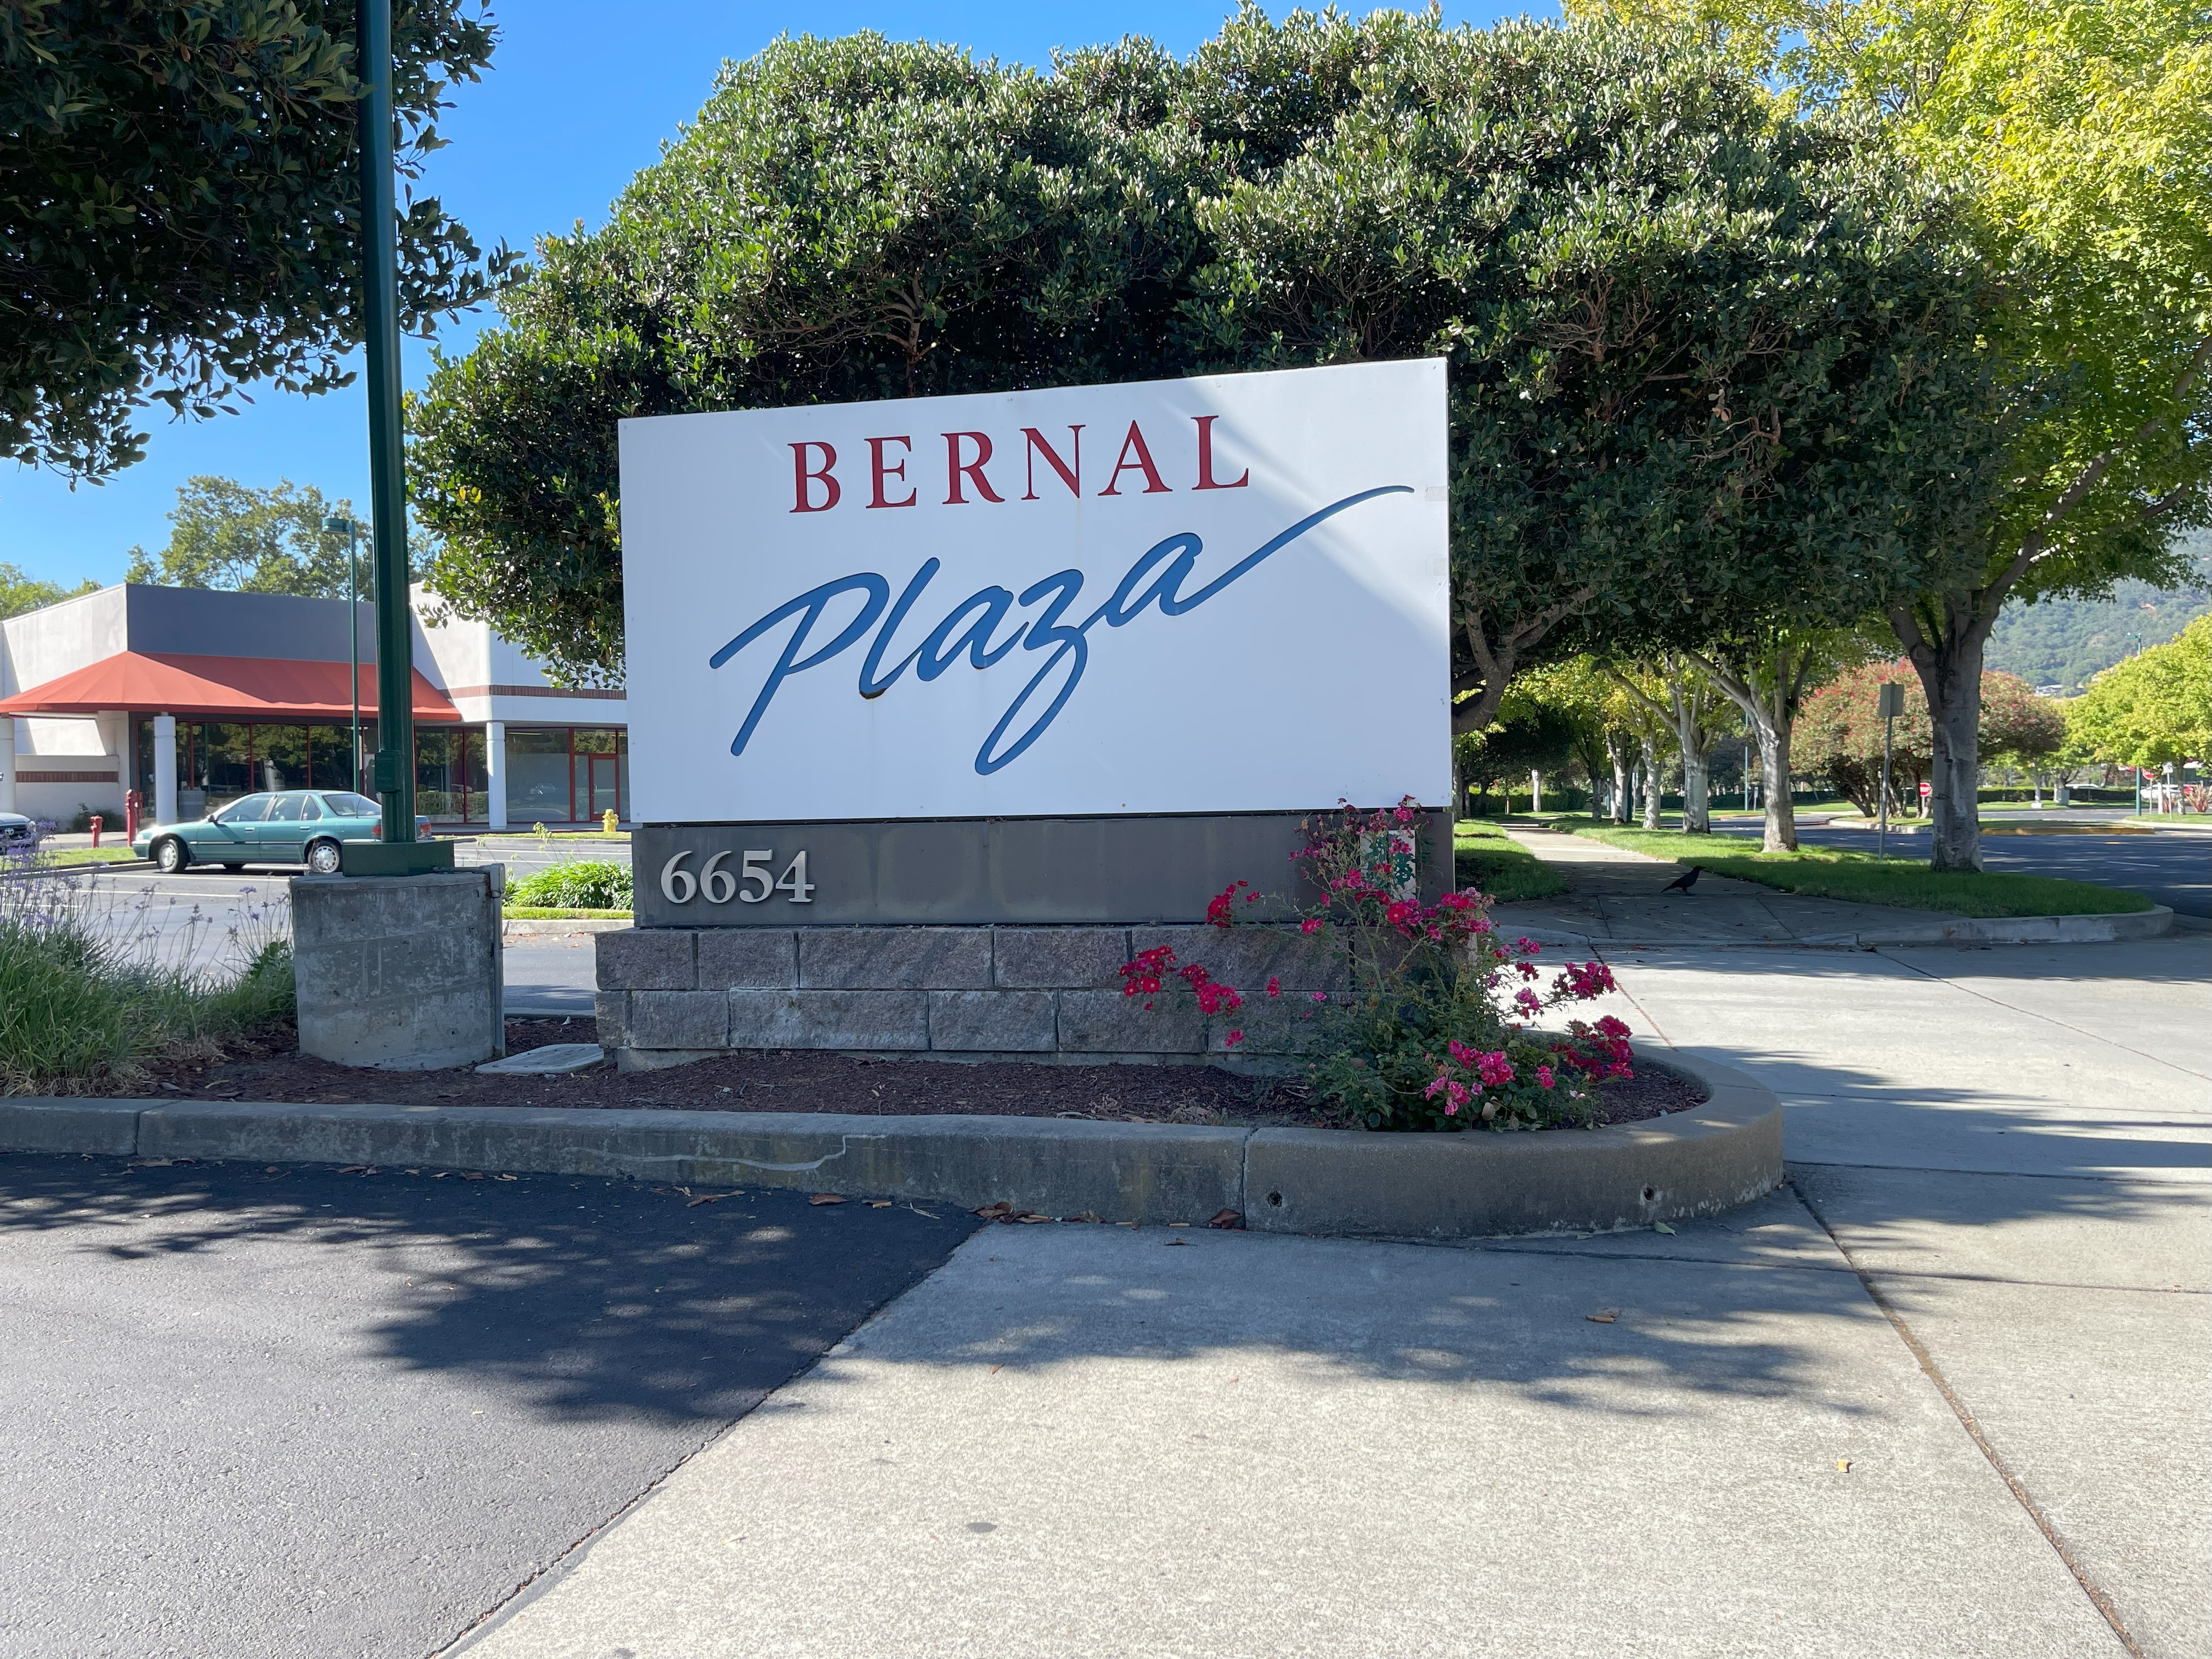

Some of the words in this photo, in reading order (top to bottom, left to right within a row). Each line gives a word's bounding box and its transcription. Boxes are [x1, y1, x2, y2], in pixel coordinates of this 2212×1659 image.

[789, 414, 1250, 513] BERNAL
[709, 485, 1414, 775] Plaza
[661, 849, 816, 904] 6654
